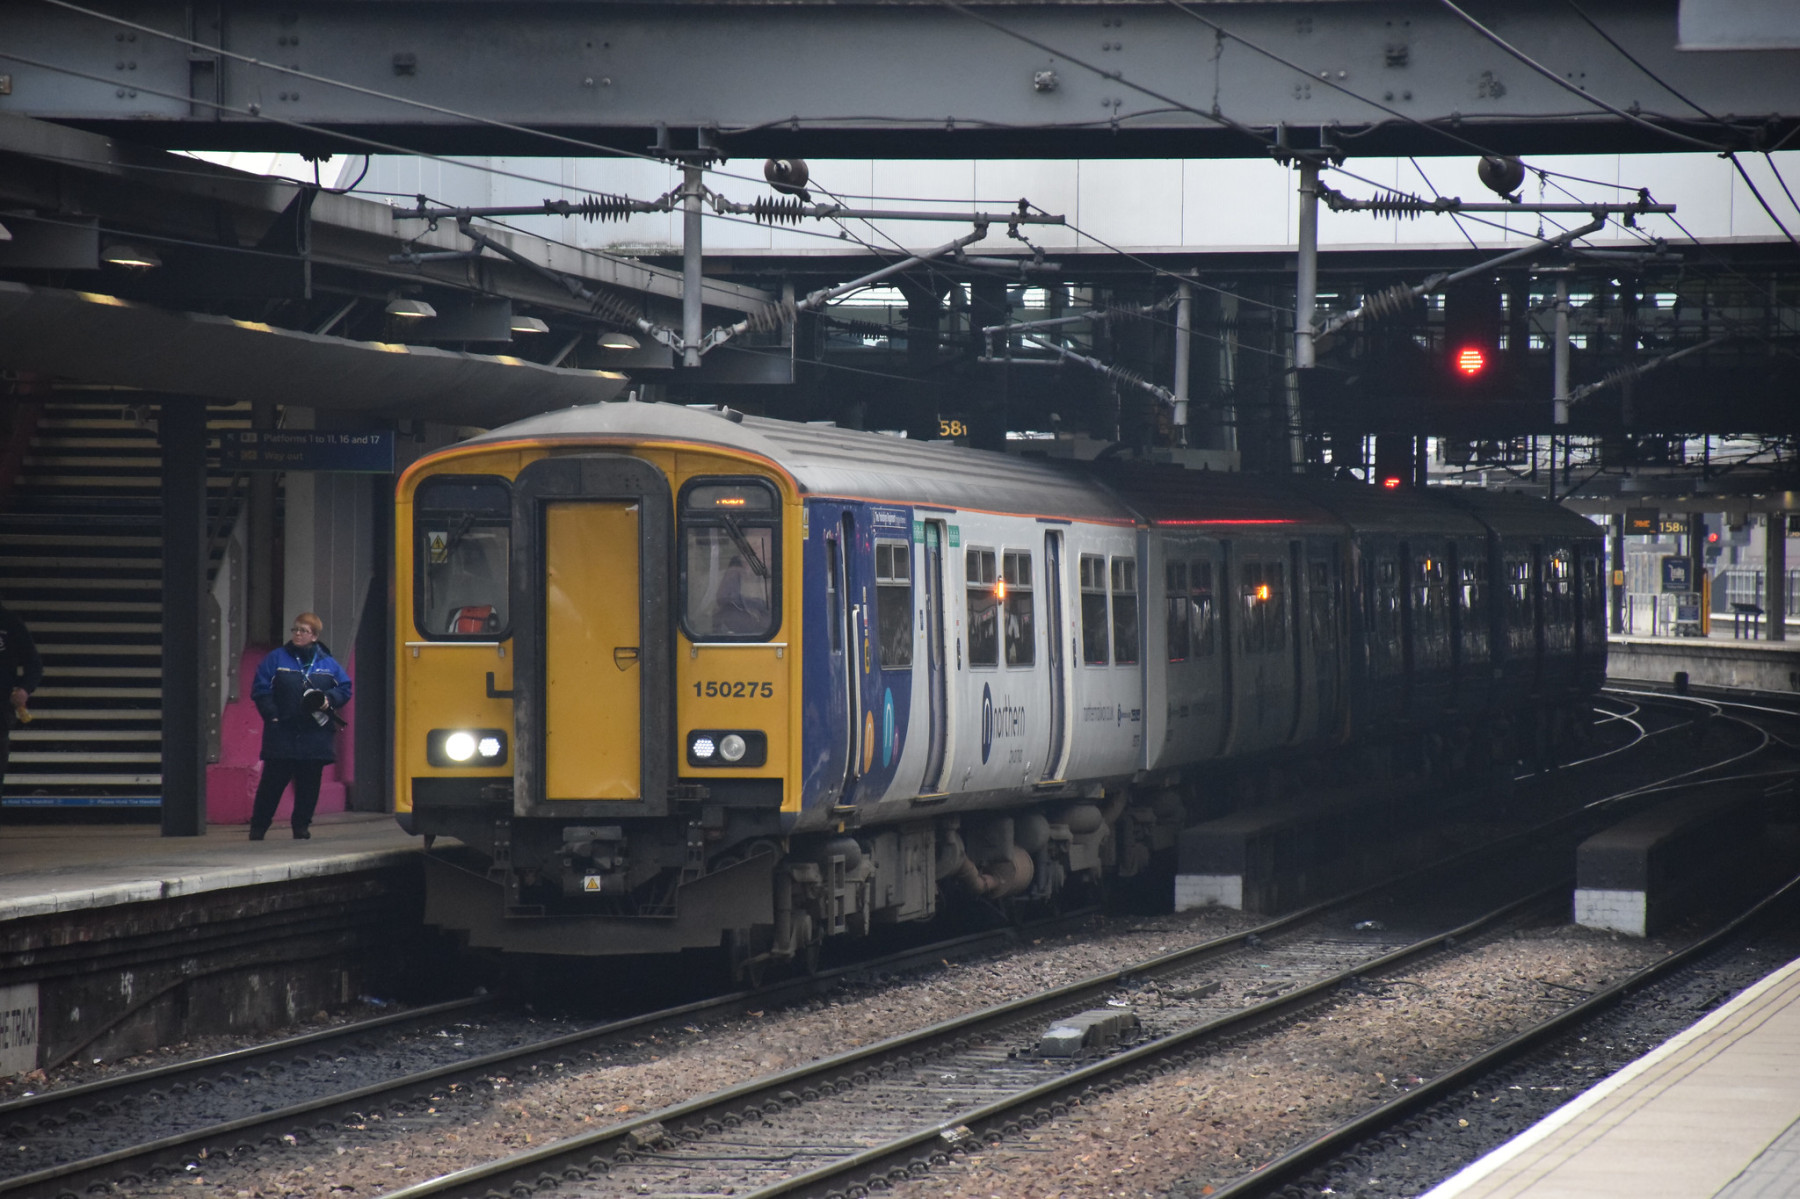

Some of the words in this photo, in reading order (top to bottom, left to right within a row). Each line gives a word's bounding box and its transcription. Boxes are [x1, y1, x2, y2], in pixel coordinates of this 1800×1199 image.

[264, 434, 306, 443] Platforms
[315, 435, 325, 443] to
[339, 434, 349, 444] 16
[351, 435, 368, 444] and
[370, 435, 380, 445] 17
[264, 452, 285, 462] Way
[287, 452, 303, 461] out
[693, 681, 773, 698] 150275
[993, 694, 1026, 738] northern
[12, 1006, 37, 1048] TRACK
